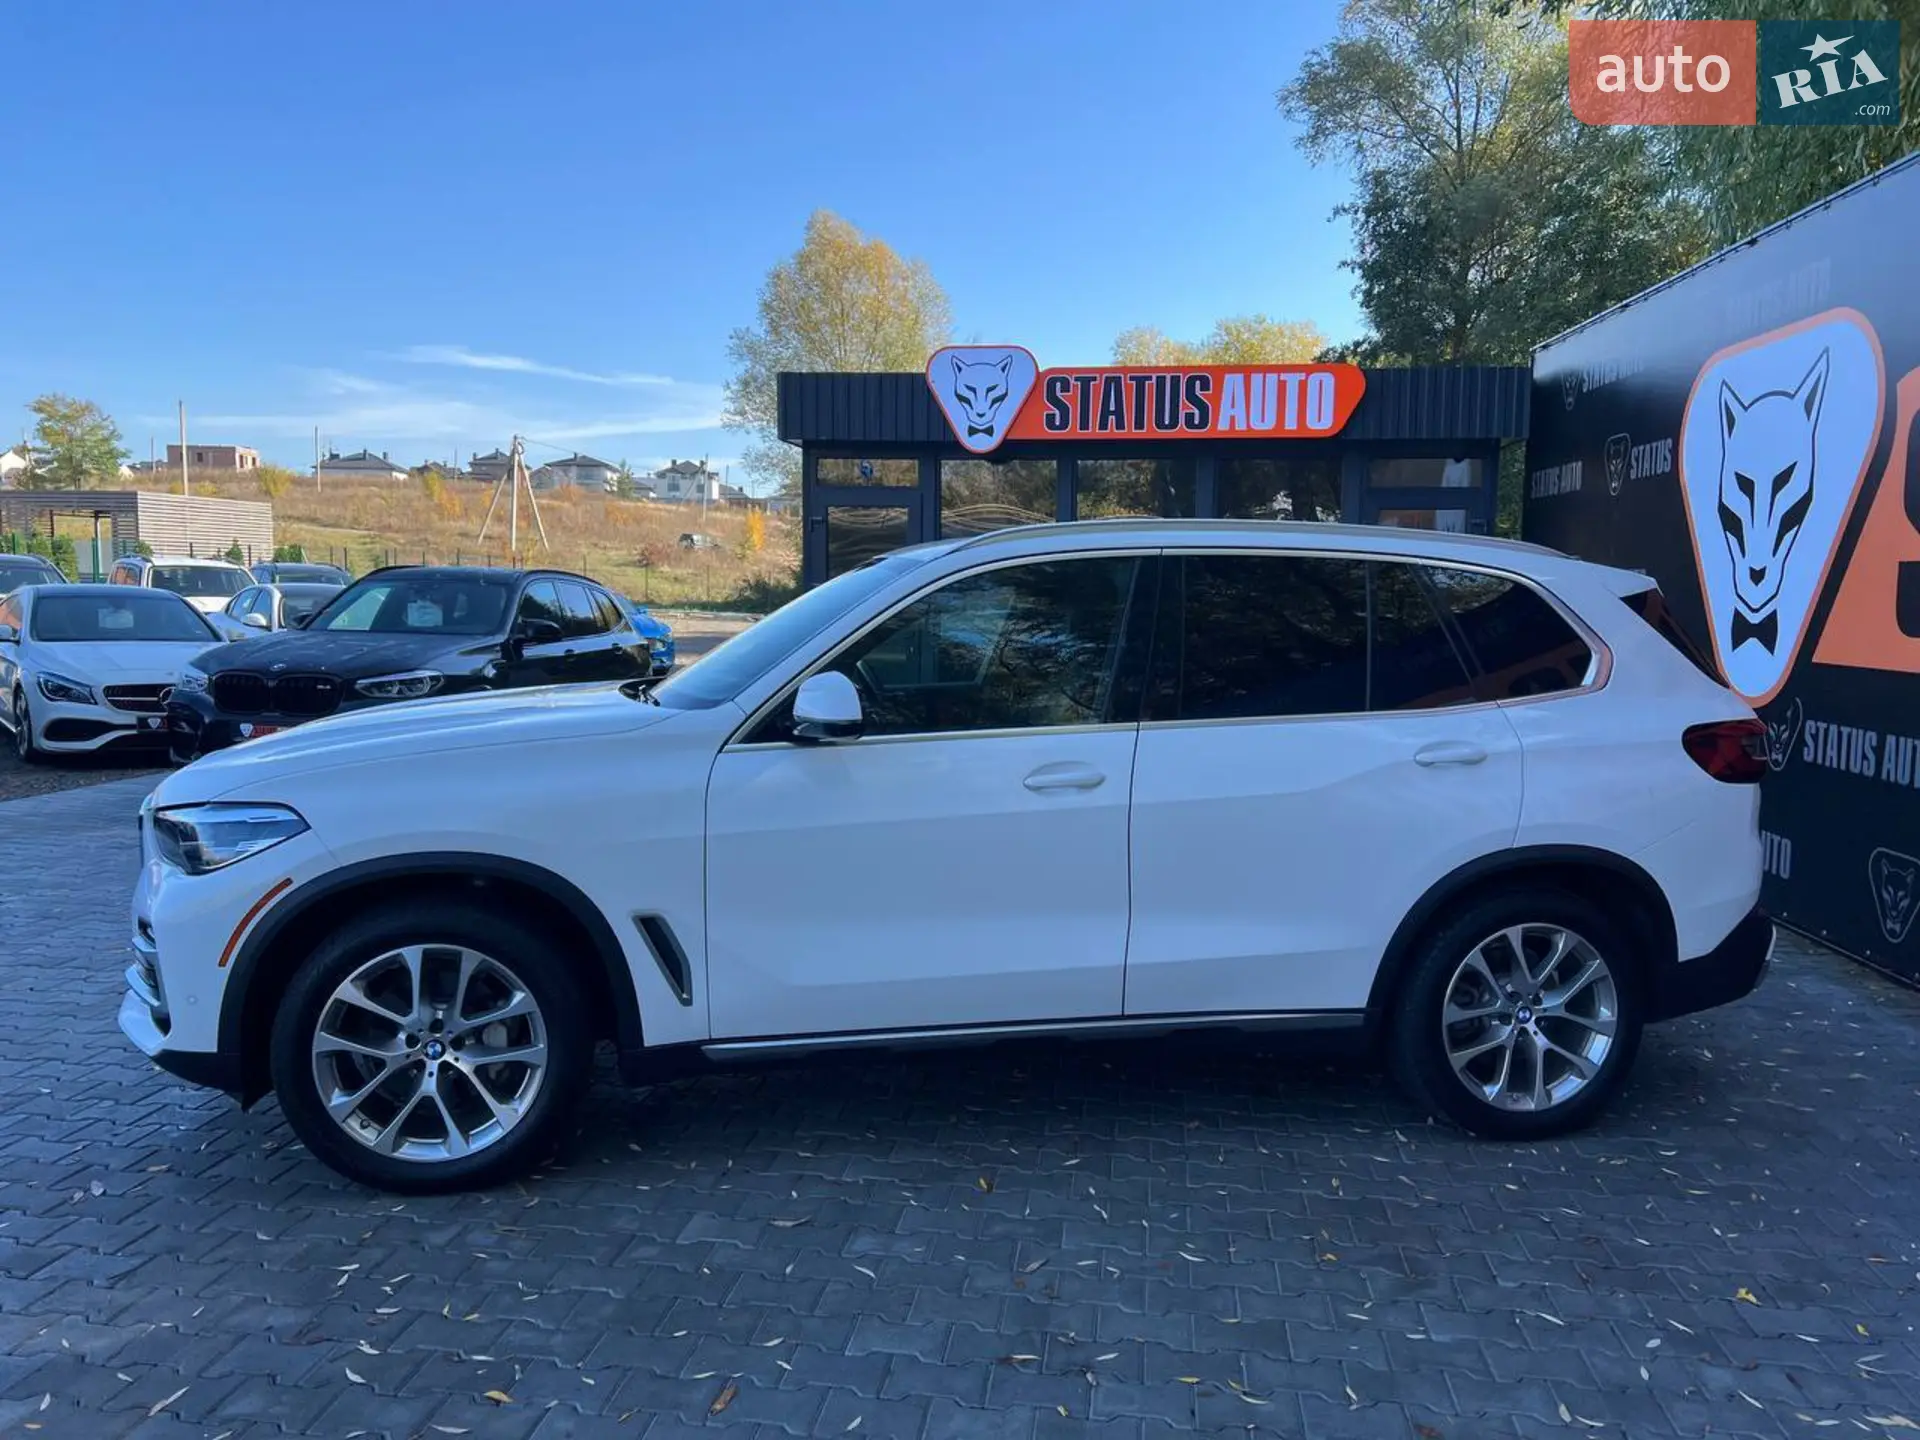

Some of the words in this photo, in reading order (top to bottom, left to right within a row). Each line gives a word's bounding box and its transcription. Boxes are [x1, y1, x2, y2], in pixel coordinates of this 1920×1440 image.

[1043, 374, 1212, 432] STATUS
[1217, 372, 1335, 430] AUTO
[1630, 438, 1673, 480] STATUS
[1803, 720, 1878, 776] STATUS
